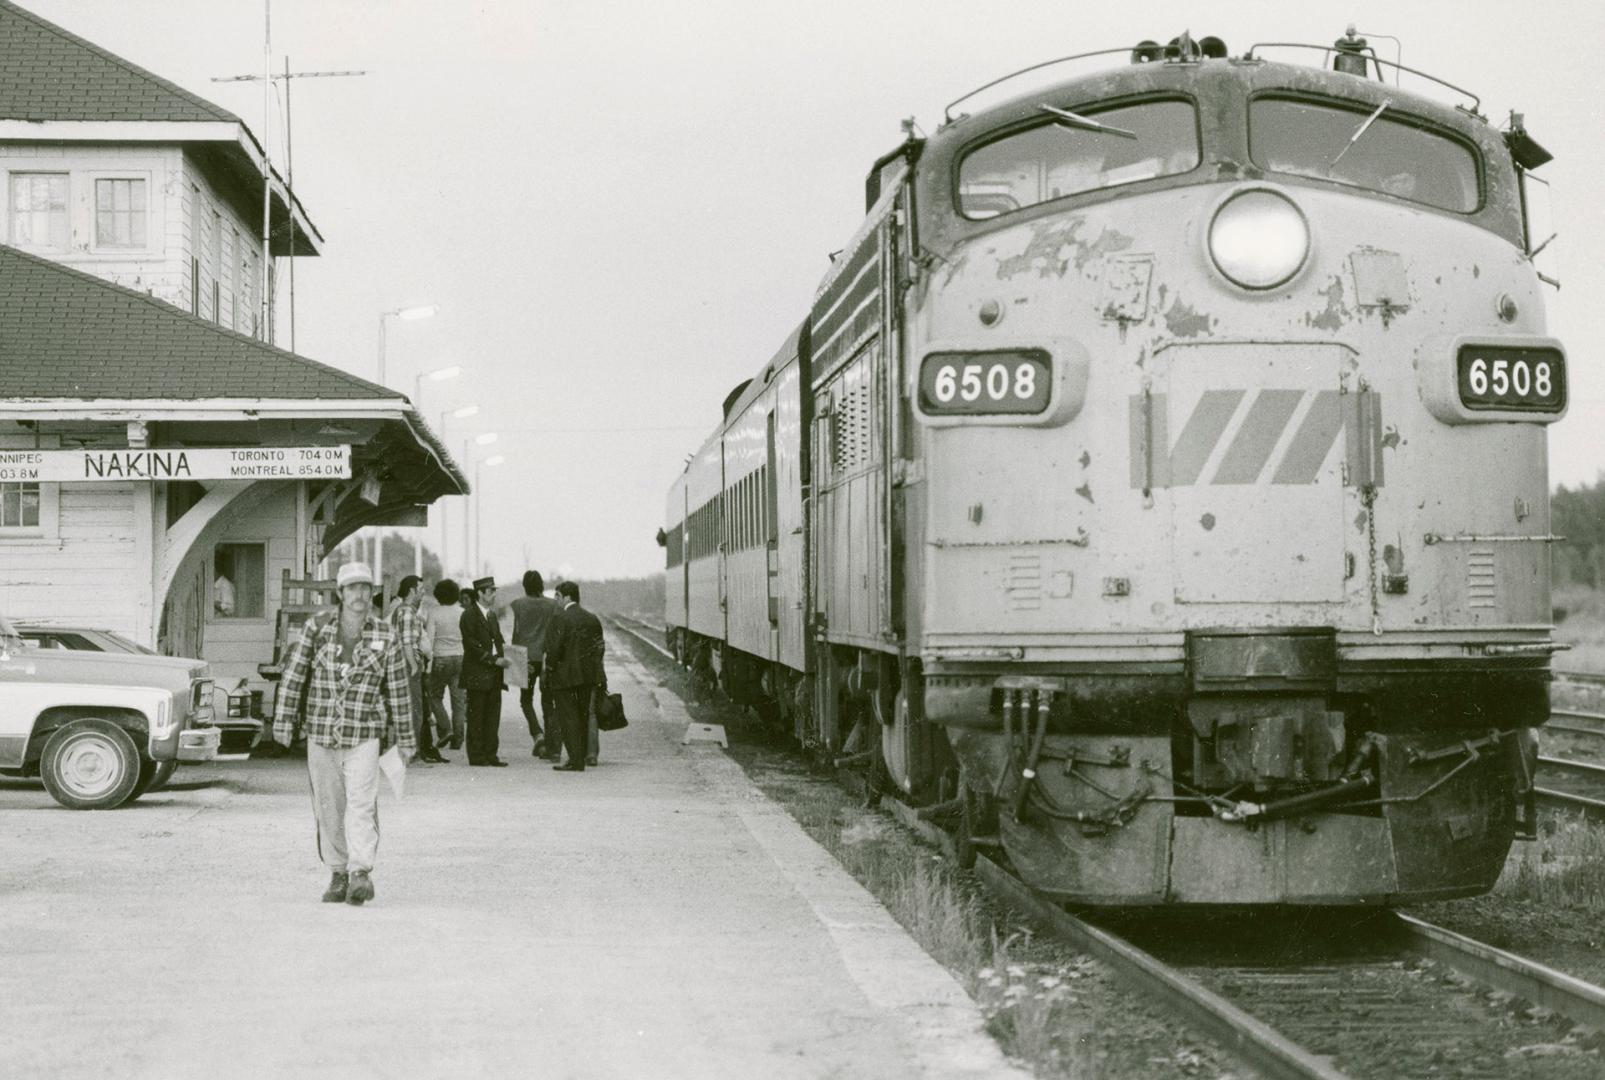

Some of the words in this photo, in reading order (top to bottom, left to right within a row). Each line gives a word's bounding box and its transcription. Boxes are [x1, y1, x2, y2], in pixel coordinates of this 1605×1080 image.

[935, 363, 1036, 402] 6508
[1469, 358, 1552, 397] 6508
[84, 452, 191, 477] NAKINA
[230, 450, 285, 461] TORONTO
[230, 465, 293, 476] MONTREAL
